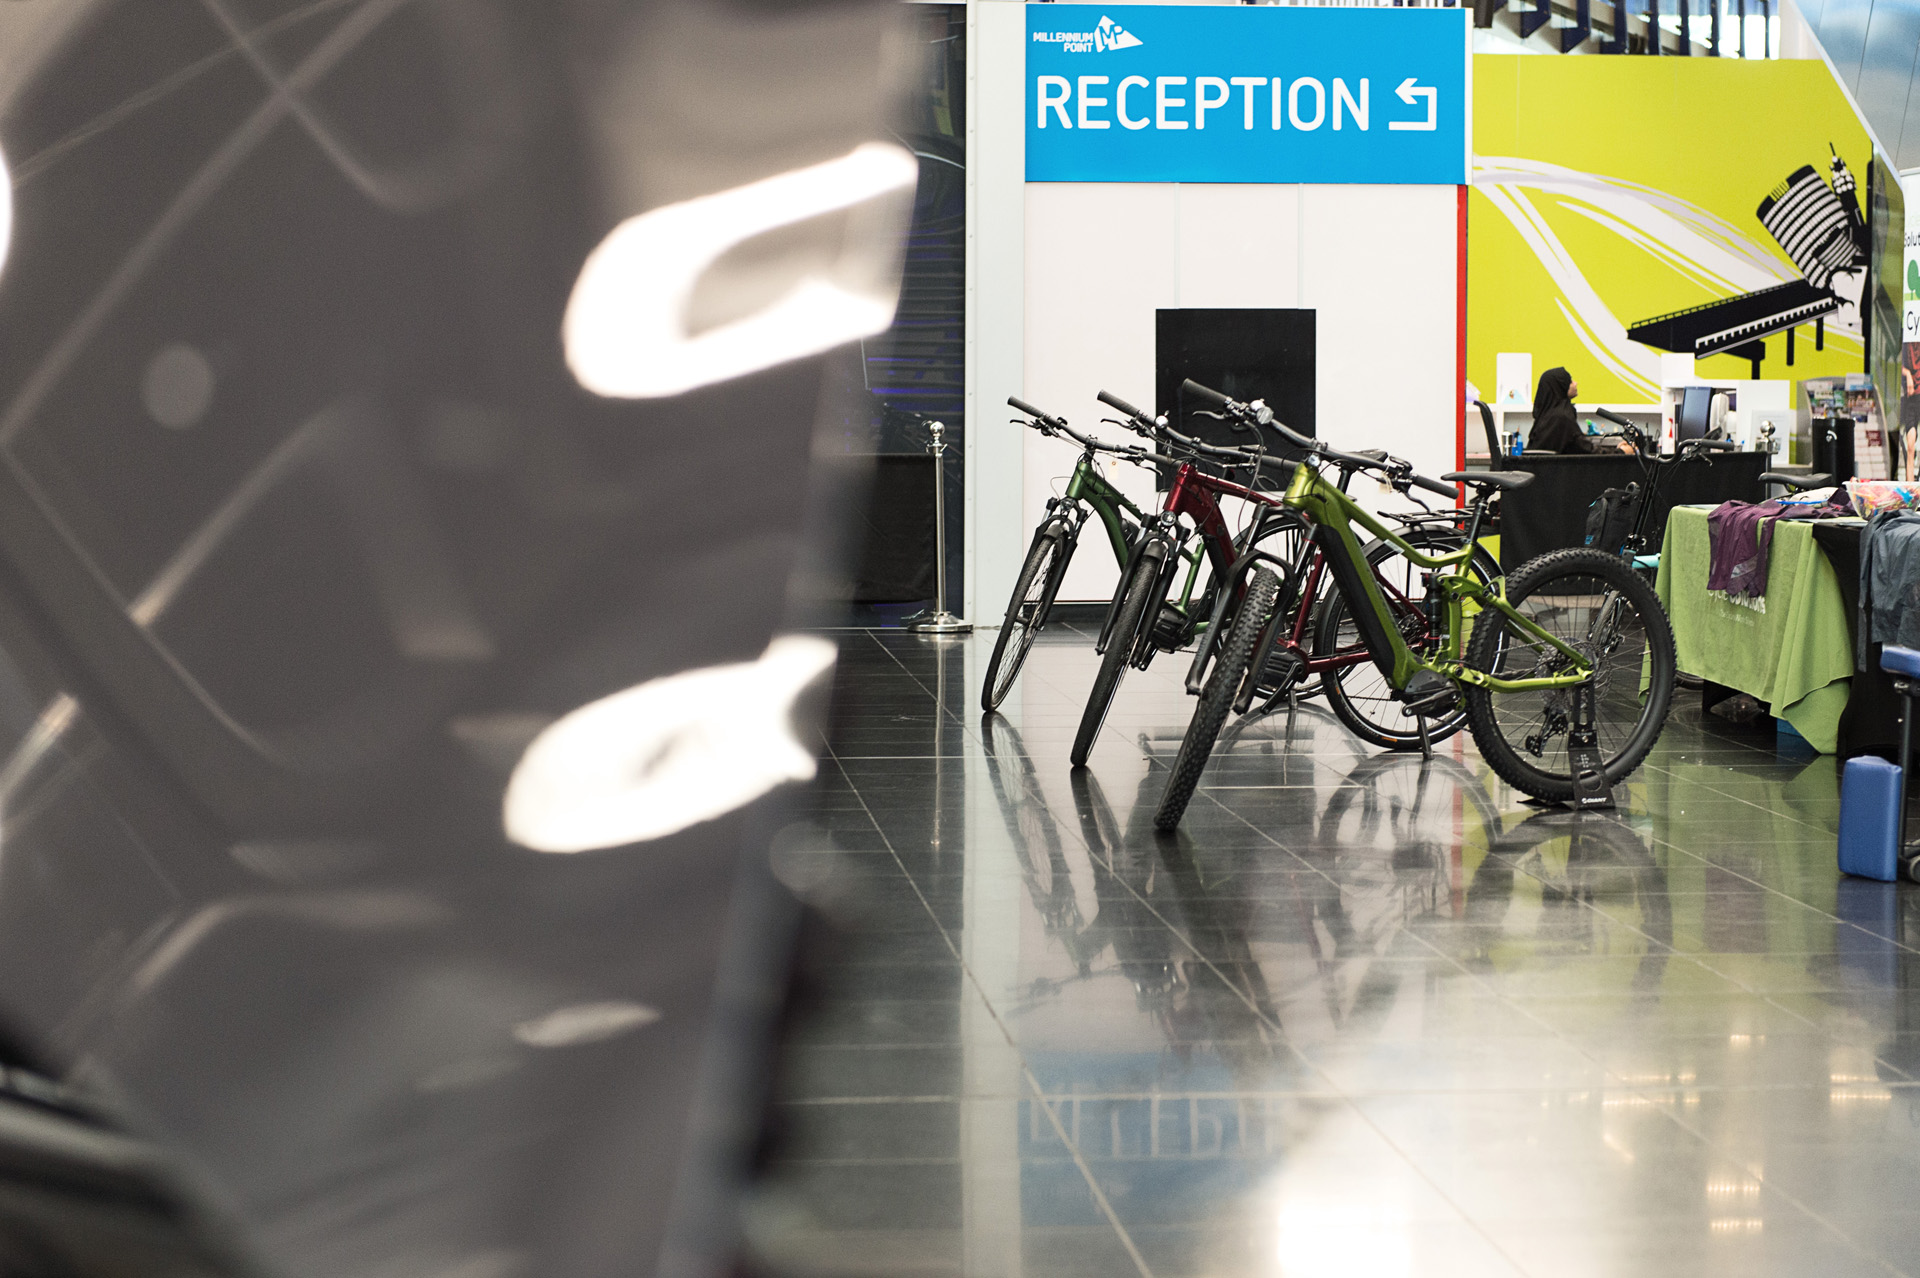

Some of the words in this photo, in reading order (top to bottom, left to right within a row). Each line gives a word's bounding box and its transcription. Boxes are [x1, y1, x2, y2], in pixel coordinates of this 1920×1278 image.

[1033, 31, 1094, 43] MILLENNIUM
[1063, 42, 1094, 53] POINT
[1037, 75, 1370, 132] RECEPTION
